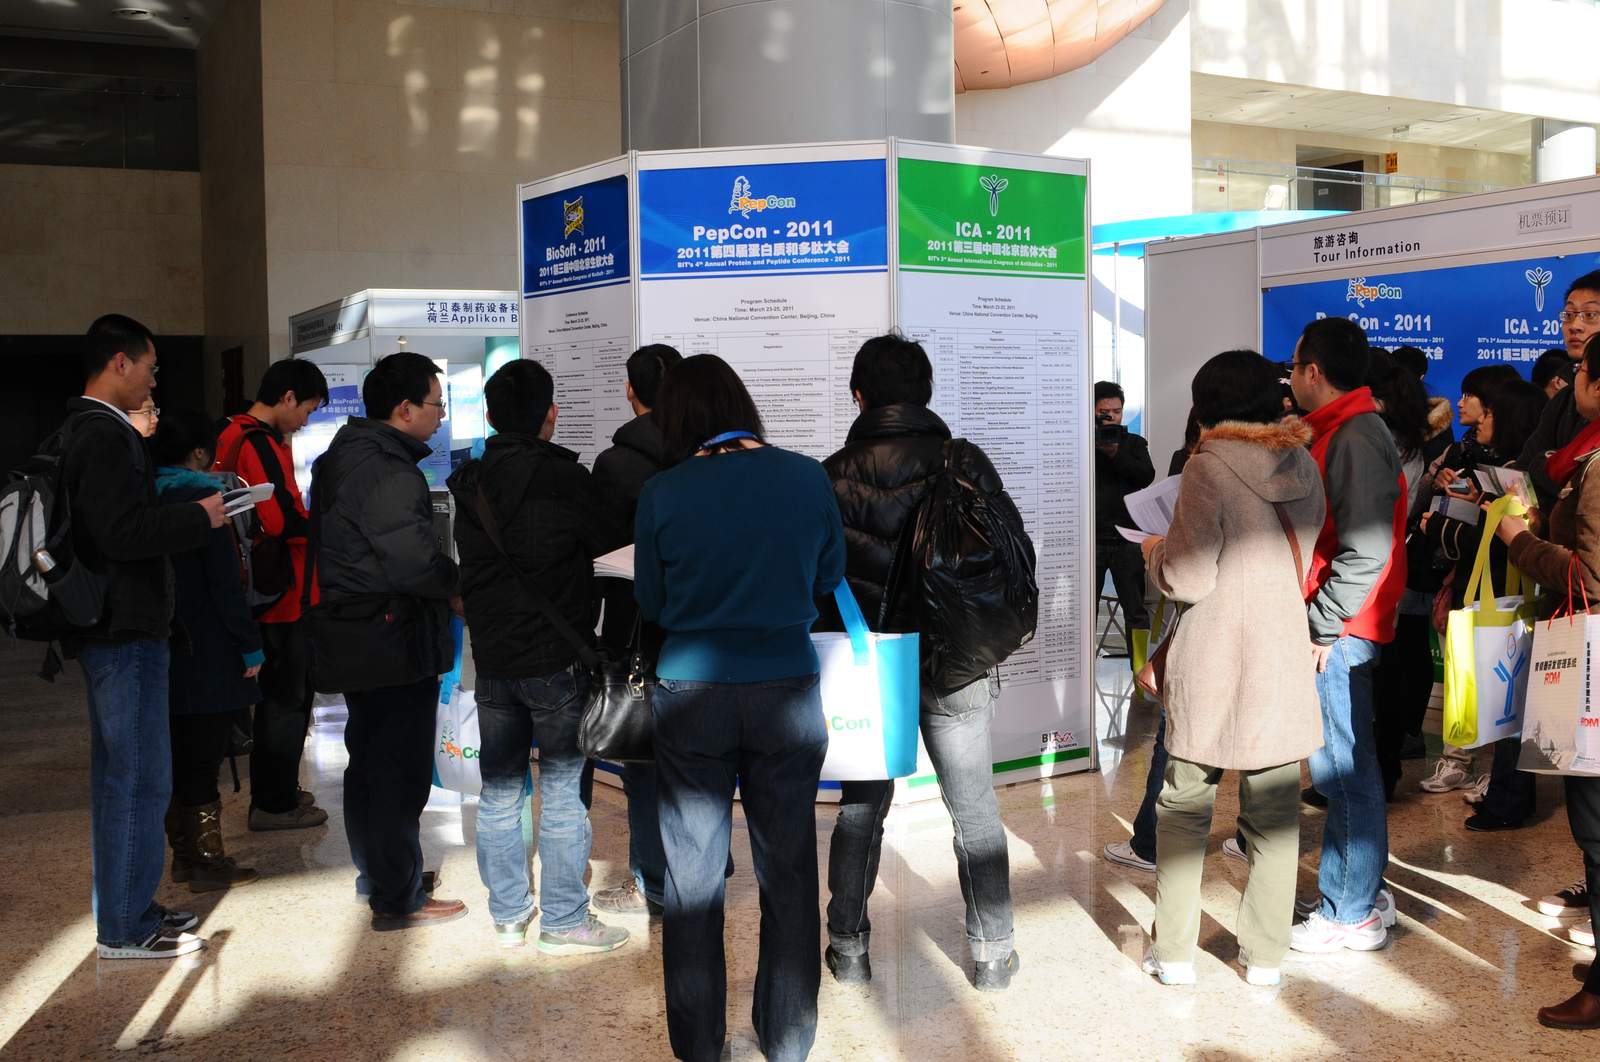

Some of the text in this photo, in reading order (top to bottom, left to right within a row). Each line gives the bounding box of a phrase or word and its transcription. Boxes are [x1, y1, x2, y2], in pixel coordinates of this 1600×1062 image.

[740, 195, 796, 212] PepCon
[1520, 210, 1567, 229] 机票预订
[694, 224, 767, 243] PepCon
[786, 220, 832, 238] 2011
[956, 222, 982, 238] ICA
[996, 224, 1030, 240] 2011
[546, 242, 576, 261] BioSoft
[584, 236, 606, 253] 2011
[677, 240, 849, 258] 2011第四届蛋白质和多肽大会
[1314, 232, 1358, 249] 旅游咨询
[1314, 241, 1420, 263] Tour Information
[1355, 284, 1402, 300] PepCon
[1394, 314, 1431, 331] 2011
[1505, 318, 1529, 335] ICA
